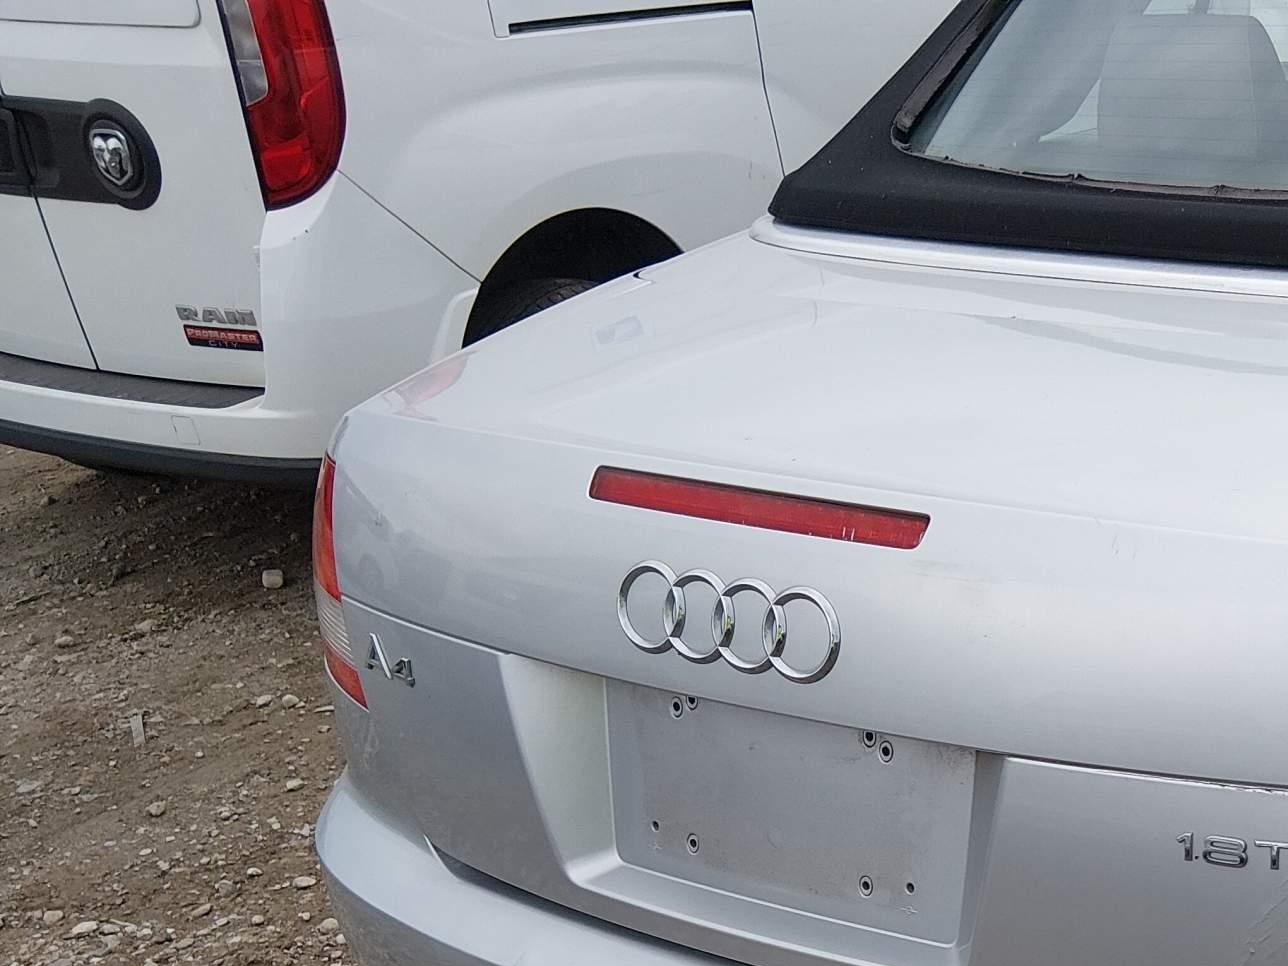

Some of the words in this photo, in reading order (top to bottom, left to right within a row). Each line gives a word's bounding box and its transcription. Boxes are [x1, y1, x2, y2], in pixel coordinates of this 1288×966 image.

[176, 304, 257, 326] RAM
[208, 339, 238, 349] CITY
[366, 632, 416, 689] A4
